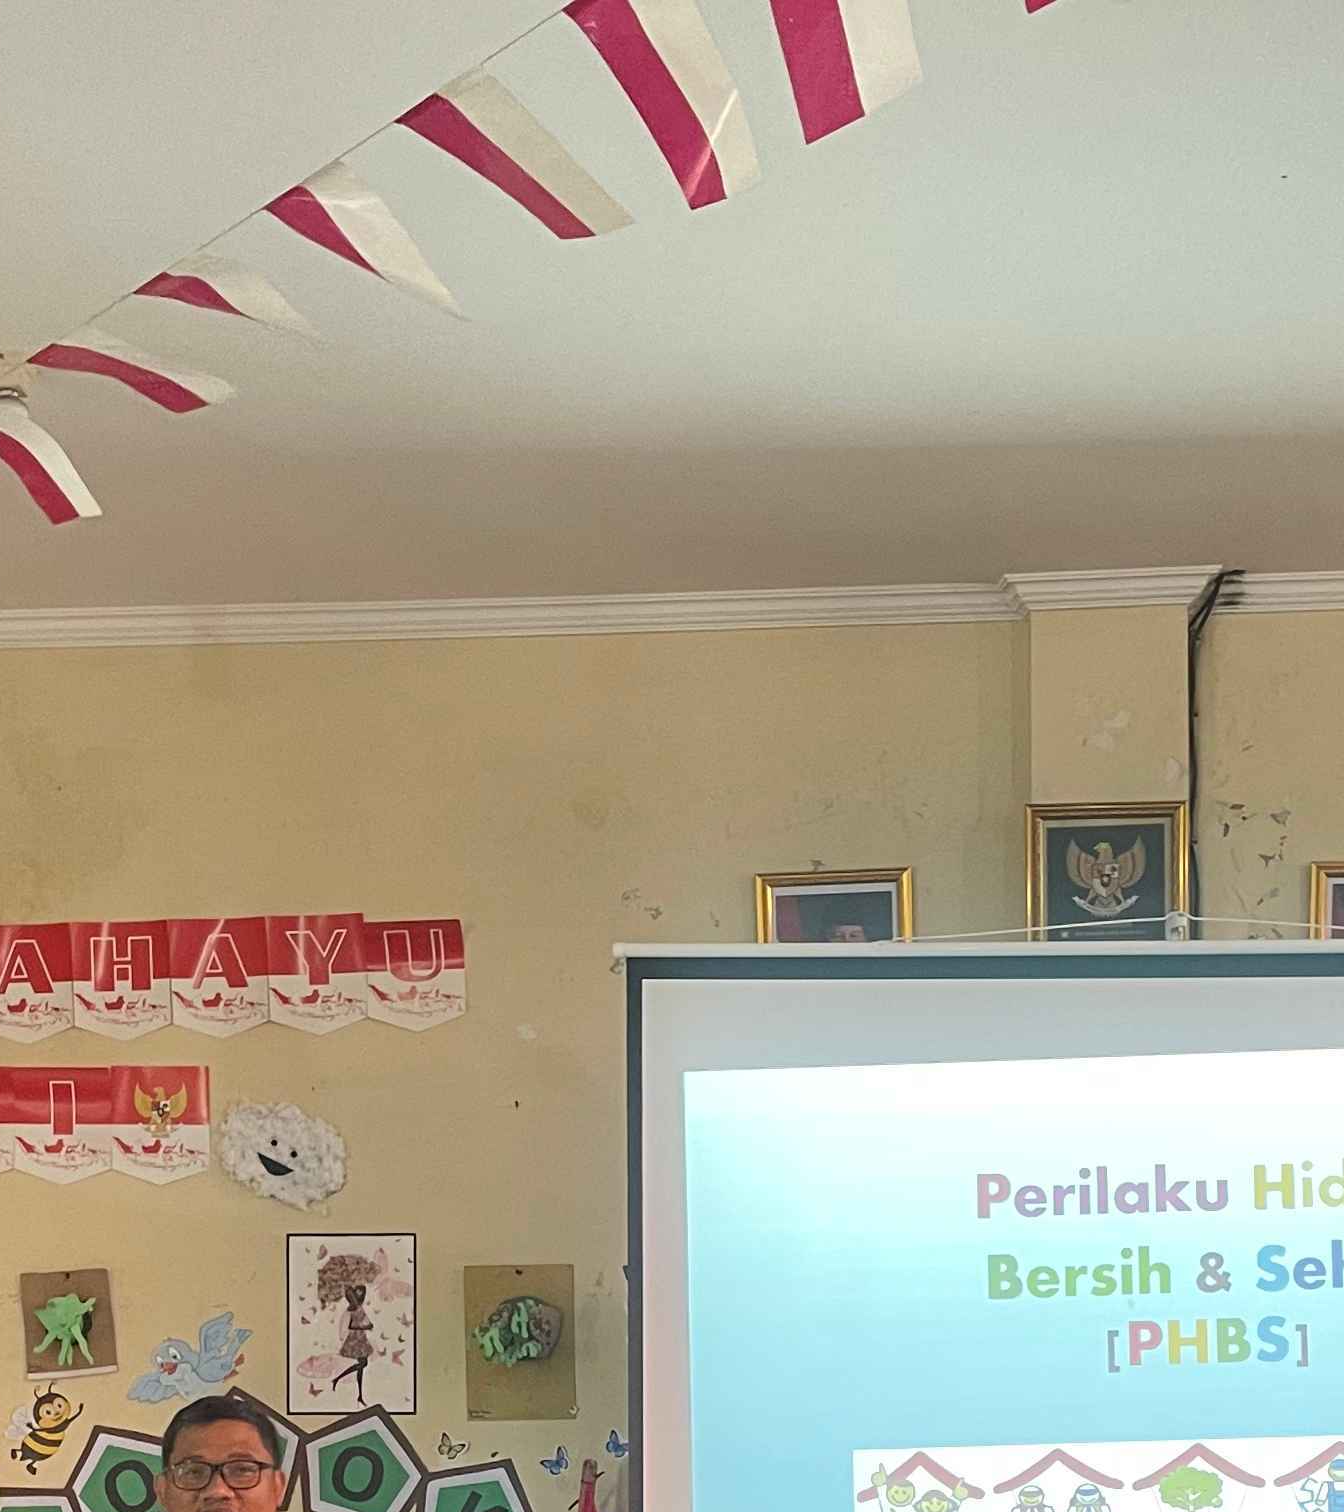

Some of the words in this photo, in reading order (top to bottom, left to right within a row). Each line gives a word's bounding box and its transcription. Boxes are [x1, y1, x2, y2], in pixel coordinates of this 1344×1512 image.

[976, 1164, 1229, 1219] Perilaku
[987, 1245, 1172, 1300] Bersih
[1195, 1251, 1232, 1293] &
[1107, 1315, 1310, 1374] [PHBS]
